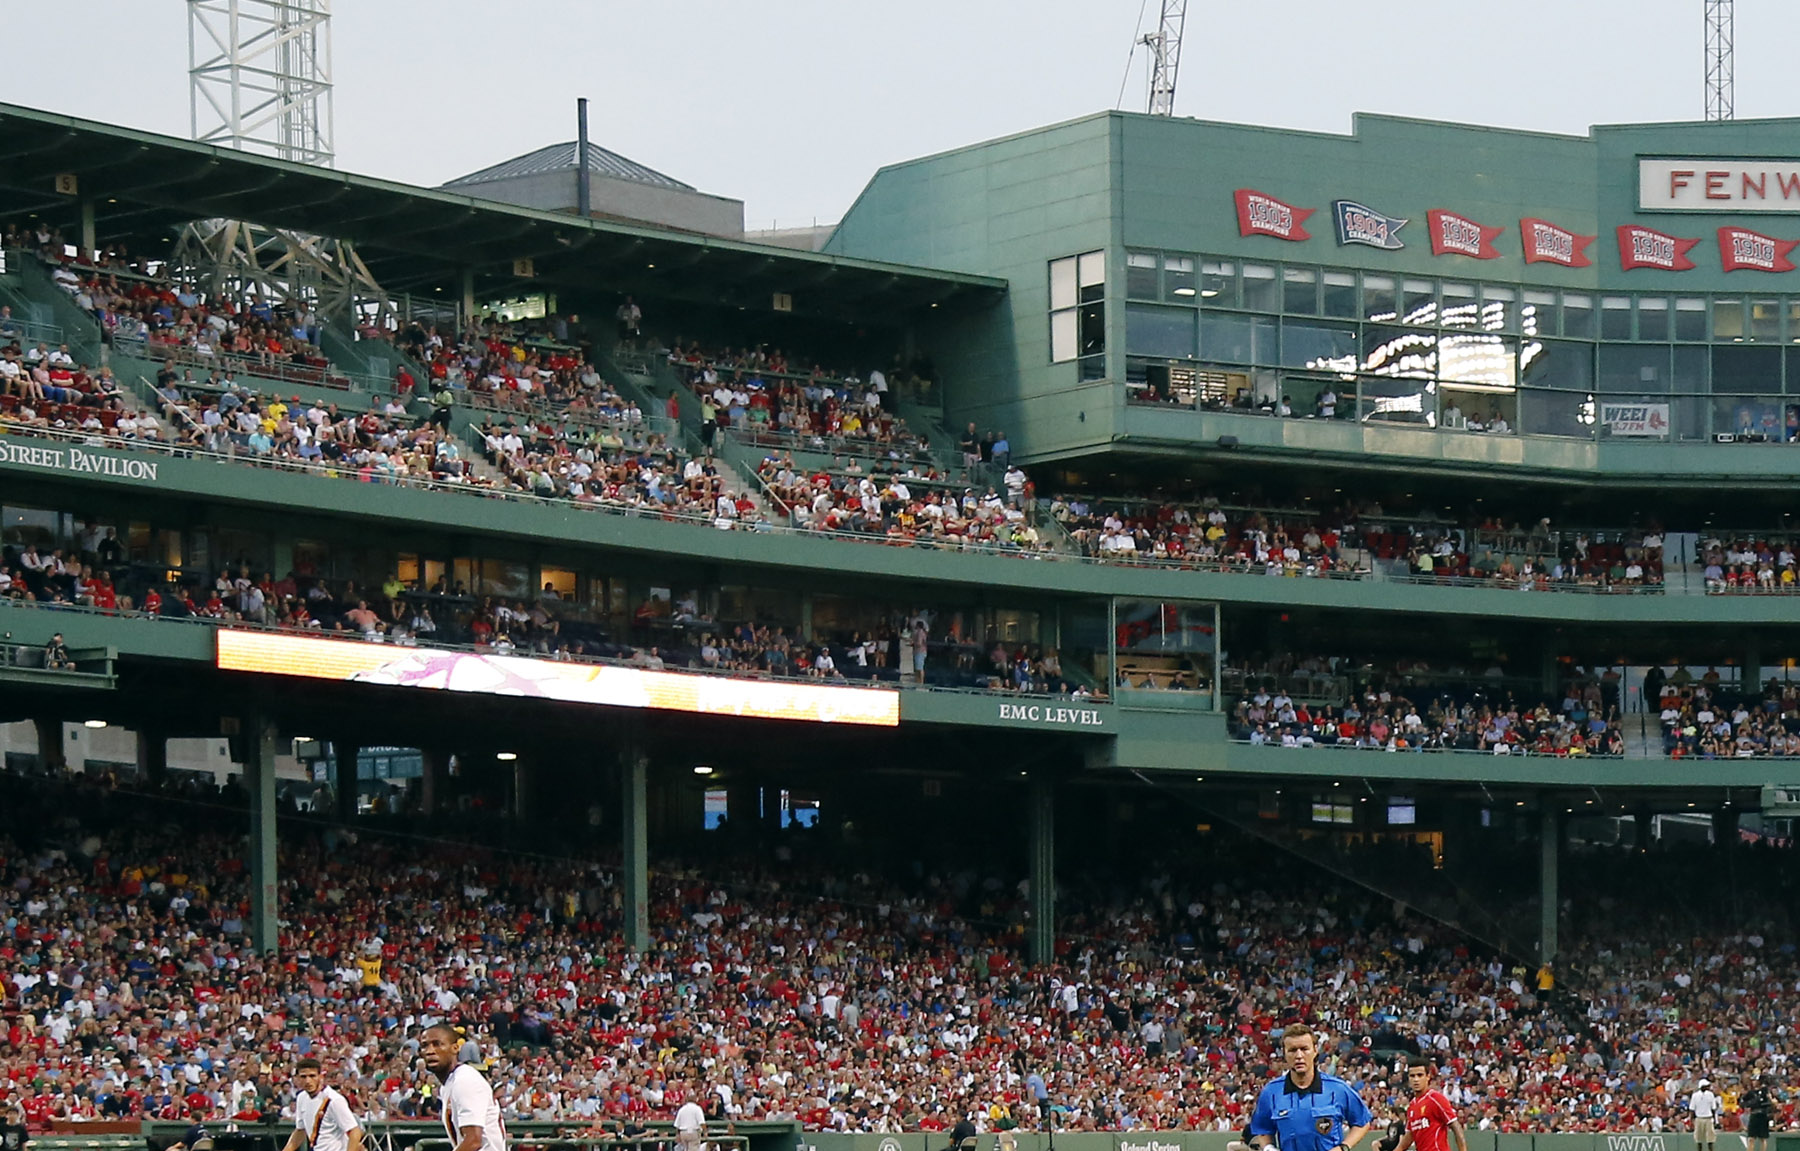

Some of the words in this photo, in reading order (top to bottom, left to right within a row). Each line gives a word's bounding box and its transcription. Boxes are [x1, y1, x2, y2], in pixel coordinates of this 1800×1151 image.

[1248, 195, 1269, 206] WORLD
[1248, 202, 1292, 229] 1903
[1440, 215, 1460, 226] WORLD
[1252, 220, 1289, 236] CHAMPIONS
[1345, 212, 1388, 238] 1904
[1533, 223, 1553, 234] WORLD
[1349, 231, 1385, 245] CHAMPIONS
[1442, 221, 1480, 248] 1912
[1631, 230, 1653, 239] WORLD
[1731, 232, 1753, 240] WORLD
[1443, 240, 1479, 255] CHAMPIONS
[1632, 237, 1674, 260] 1916
[1733, 238, 1774, 261] 1918
[1536, 248, 1571, 262] CHAMPIONS
[1634, 254, 1673, 267] CHAMPIONS
[1734, 256, 1773, 268] CHAMPIONS
[1605, 407, 1649, 421] WEEI
[69, 448, 158, 480] PAVILION
[999, 704, 1040, 720] EMC
[1045, 707, 1103, 725] LEVEL
